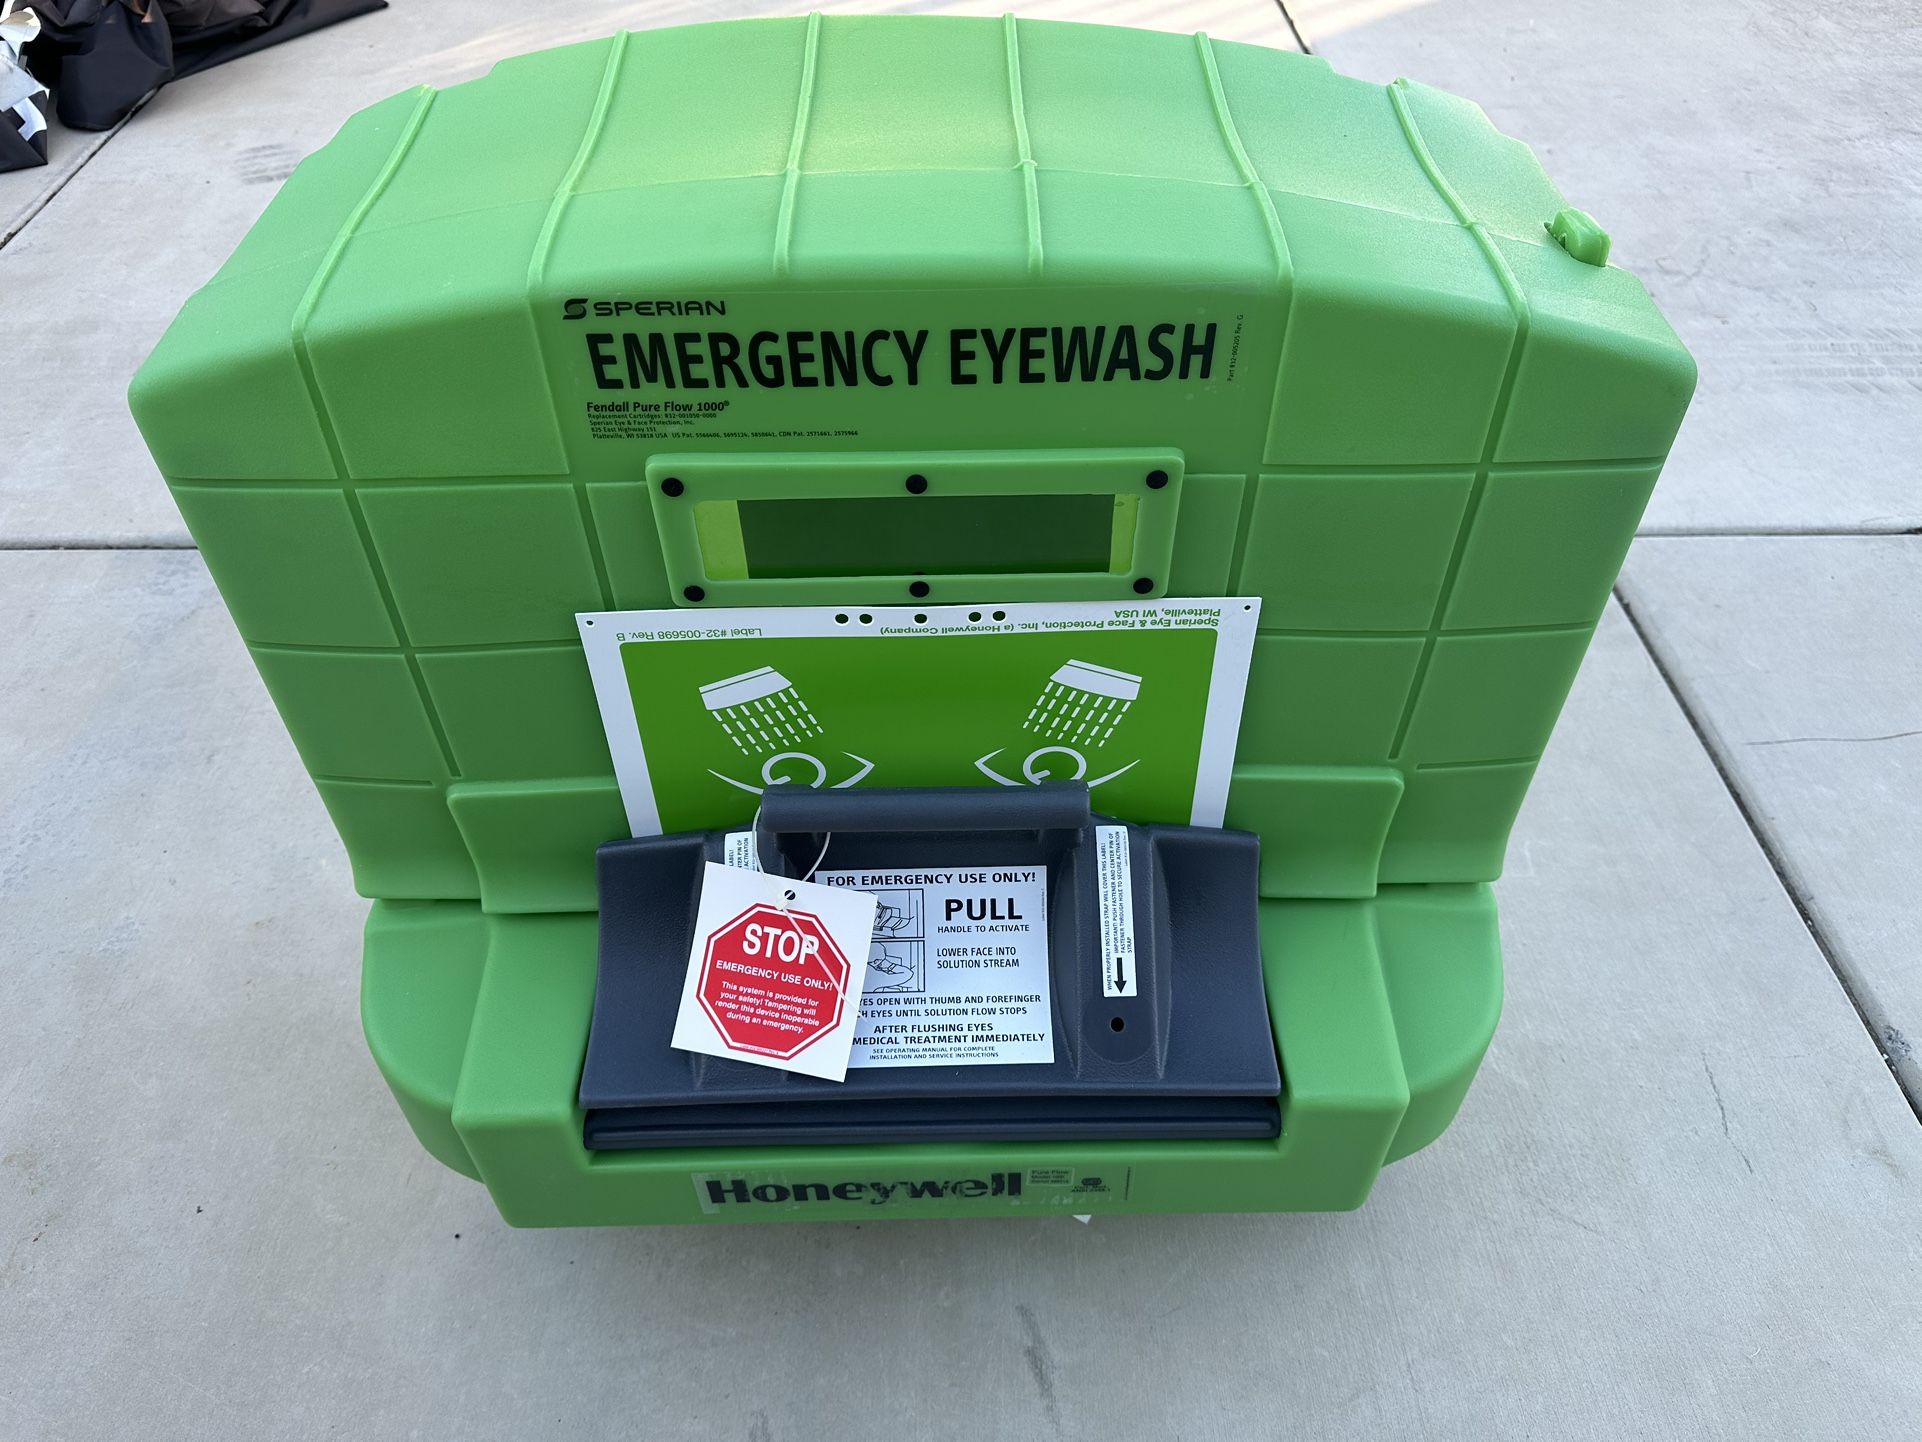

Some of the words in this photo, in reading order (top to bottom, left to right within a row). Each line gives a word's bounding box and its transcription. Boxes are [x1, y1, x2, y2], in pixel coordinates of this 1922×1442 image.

[593, 300, 726, 317] SPERIAN
[585, 329, 929, 389] EMERGENCY
[950, 323, 1217, 385] EYEWASH
[586, 401, 629, 412] Fendall
[633, 402, 660, 412] Pure
[664, 401, 693, 412] Flow
[1114, 609, 1139, 618] USA
[1142, 609, 1157, 617] WI
[1161, 608, 1221, 617] Platteville,
[1018, 622, 1038, 630] Inc.
[1042, 620, 1104, 629] Protection,
[1108, 620, 1135, 628] Face
[1139, 619, 1148, 627] &
[1150, 618, 1171, 627] Eye
[1174, 618, 1219, 627] Sperian
[731, 628, 762, 637] Label
[880, 626, 939, 635] Company)
[941, 625, 1001, 634] Honeywell
[1003, 624, 1014, 632] (a
[616, 632, 626, 641] B
[628, 631, 654, 640] Rev.
[657, 629, 727, 640] #32-005698
[827, 875, 857, 886] FOR
[861, 873, 953, 886] EMERGENCY
[958, 873, 987, 883] USE
[992, 872, 1036, 883] ONLY!
[1117, 880, 1123, 888] TO
[945, 897, 1023, 921] PULL
[937, 925, 972, 933] HANDLE
[975, 925, 986, 933] TO
[989, 924, 1030, 932] ACTIVATE
[742, 922, 820, 965] STOP
[937, 948, 968, 957] LOWER
[971, 947, 993, 956] FACE
[995, 947, 1017, 956] INTO
[937, 960, 981, 969] SOLUTION
[983, 959, 1020, 968] STREAM
[716, 960, 779, 980] EMERGENCY
[781, 973, 801, 985] USE
[803, 977, 833, 991] ONLY!
[722, 981, 737, 991] This
[738, 984, 765, 996] system
[767, 990, 774, 998] is
[775, 992, 807, 1005] provided
[808, 999, 819, 1007] for
[720, 992, 737, 1000] your
[738, 994, 763, 1005] safety!
[764, 999, 802, 1014] Tampering
[803, 1008, 817, 1016] will
[876, 997, 900, 1006] OPEN
[903, 997, 926, 1005] WITH
[929, 996, 961, 1004] THUMB
[964, 996, 983, 1004] AND
[986, 995, 1041, 1004] FOREFINGER
[715, 1000, 739, 1010] render
[740, 1004, 754, 1013] this
[755, 1007, 780, 1018] device
[781, 1011, 820, 1026] inoperable
[871, 1010, 893, 1018] EYES
[895, 1009, 921, 1017] UNTIL
[924, 1008, 968, 1017] SOLUTION
[971, 1007, 997, 1016] FLOW
[999, 1007, 1027, 1015] STOPS
[726, 1011, 750, 1023] during
[762, 1019, 804, 1034] emergency.
[873, 1025, 908, 1034] AFTER
[911, 1023, 964, 1033] FLUSHING
[967, 1023, 993, 1032] EYES
[852, 1036, 900, 1046] MEDICAL
[904, 1034, 968, 1044] TREATMENT
[971, 1033, 1045, 1043] IMMEDIATELY
[706, 1172, 1022, 1205] Honeywell
